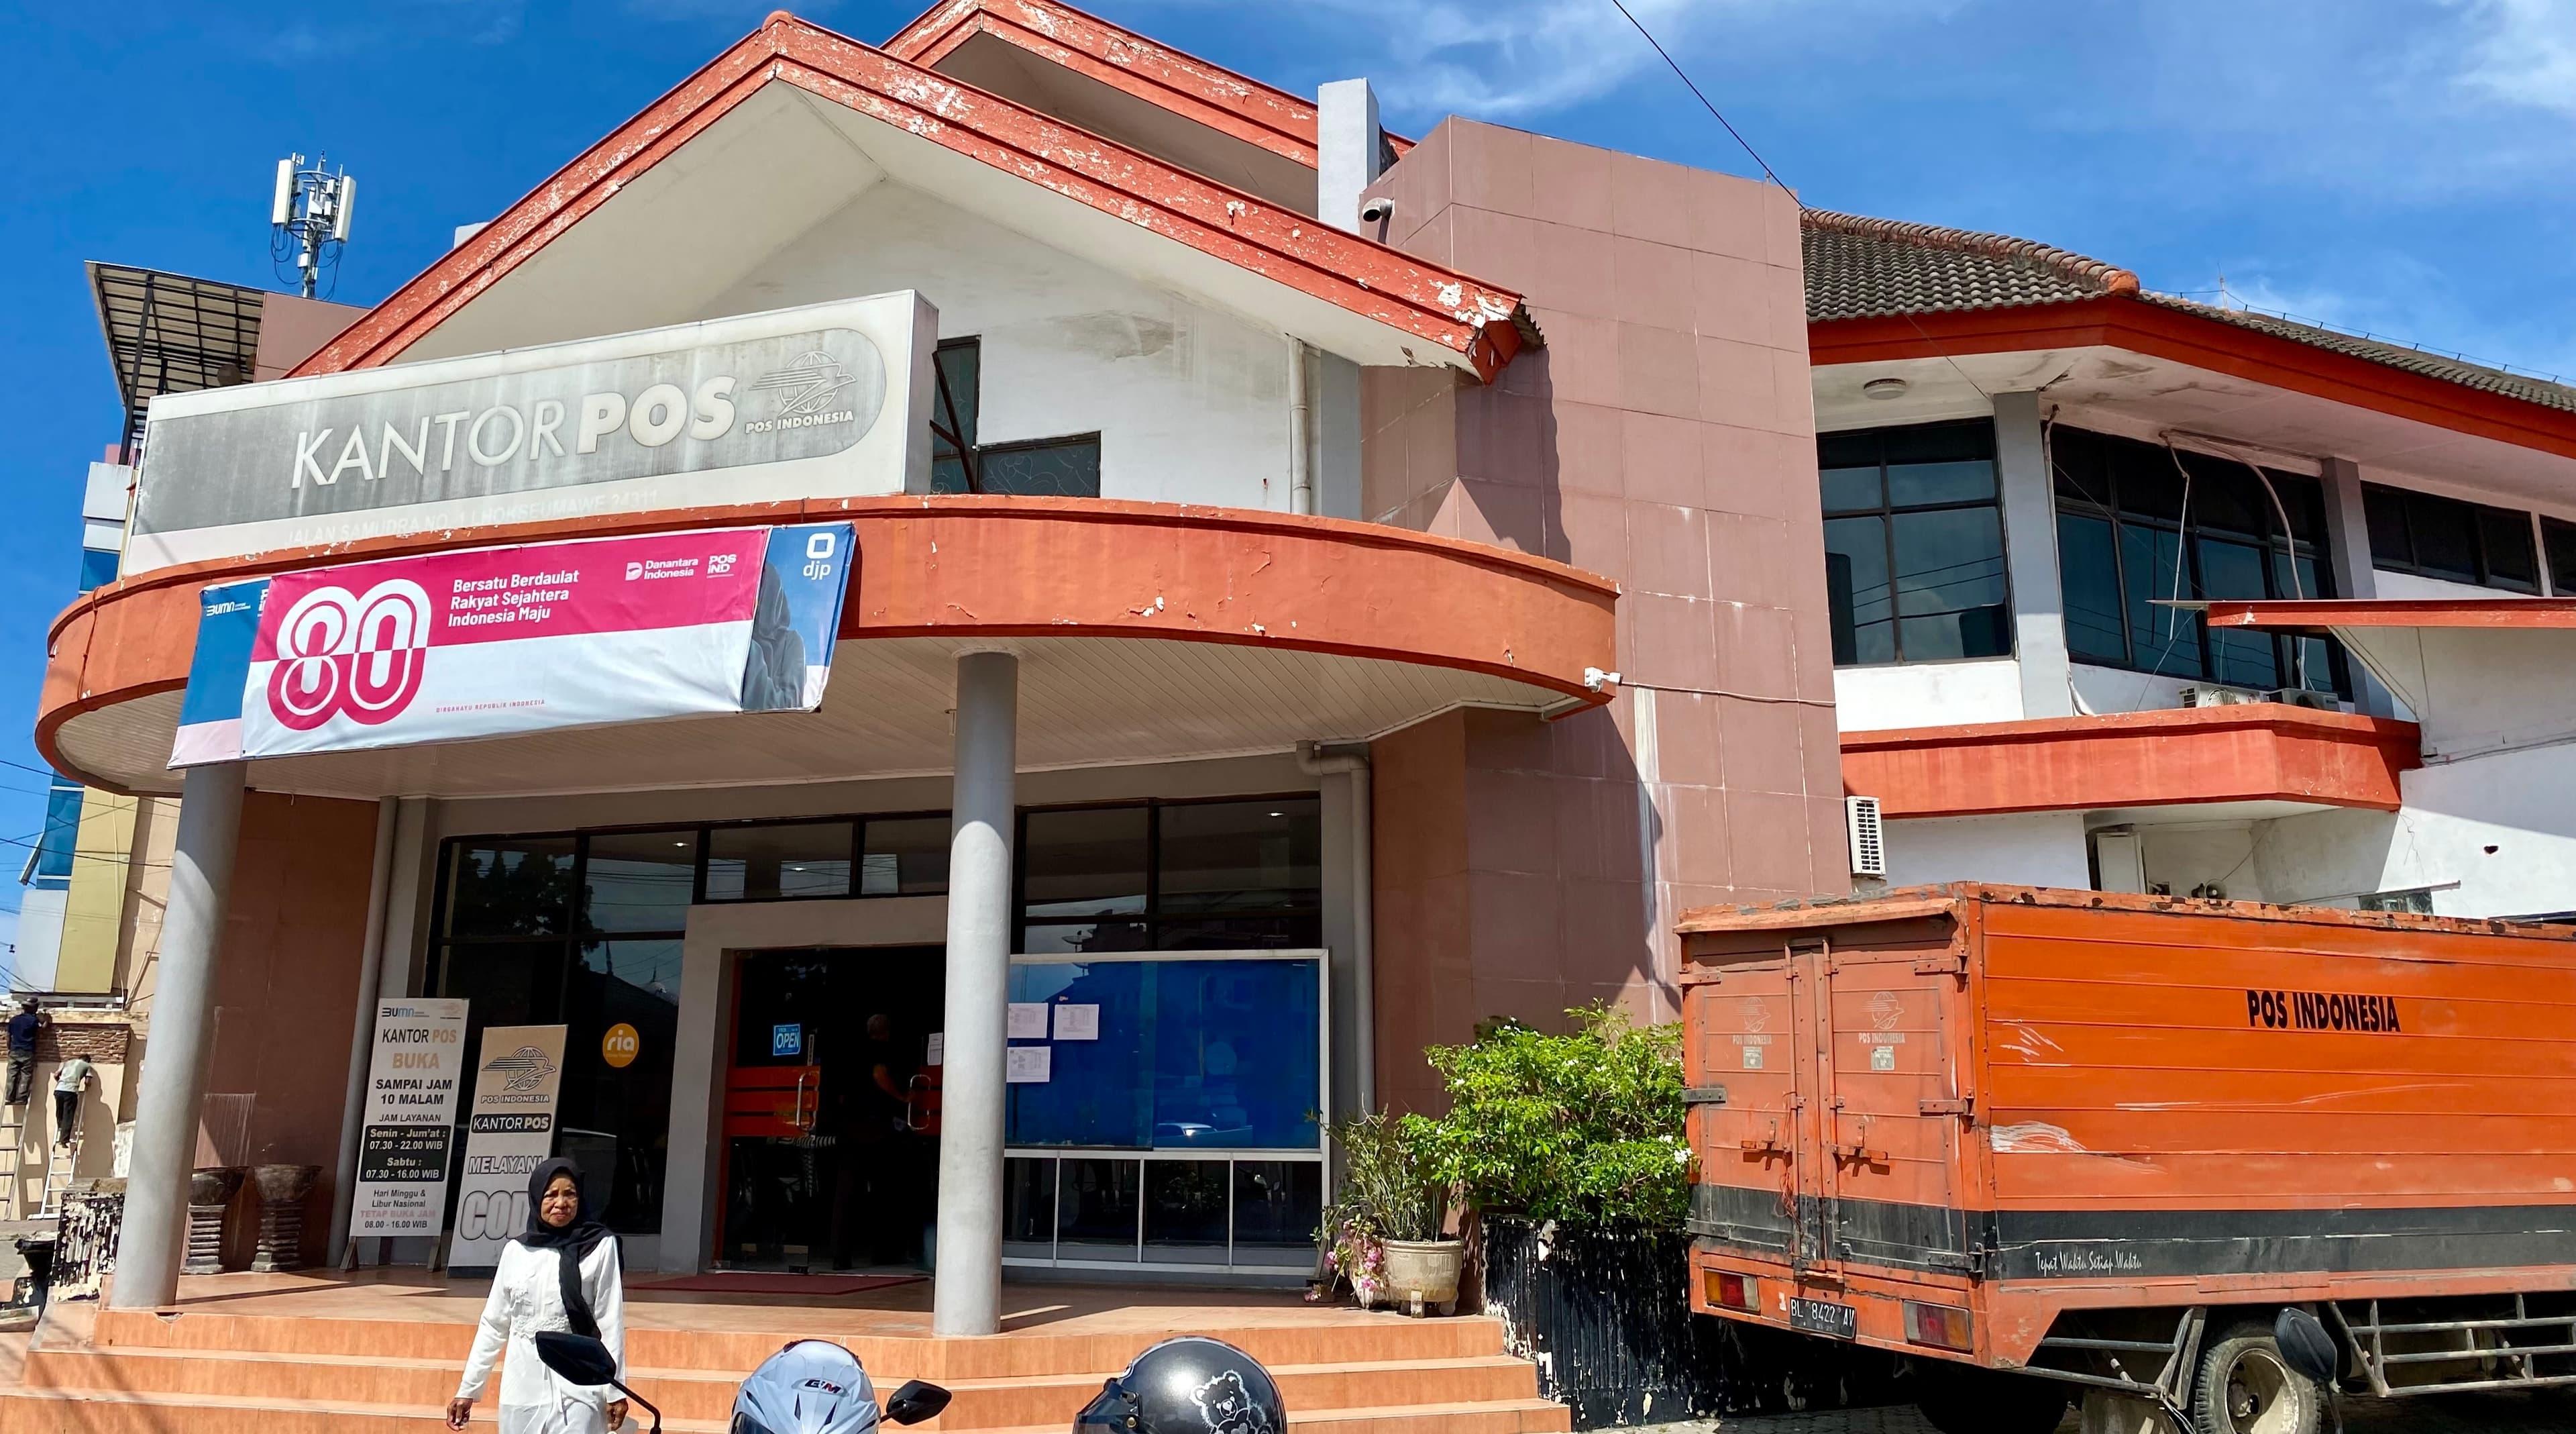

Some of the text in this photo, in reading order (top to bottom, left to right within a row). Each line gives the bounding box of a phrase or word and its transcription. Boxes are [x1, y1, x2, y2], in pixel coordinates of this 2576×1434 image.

[745, 409, 855, 435] POS INDONESIA
[291, 374, 737, 489] KANTOR POS
[286, 525, 337, 546] JALAN
[339, 517, 419, 541] SAMUDRA
[472, 494, 608, 523] LHOKSEUMAWE
[645, 553, 737, 570] Danantara POS
[643, 567, 695, 580] Indonesia
[802, 560, 832, 580] djp
[453, 570, 580, 593] Bersatu Berdaulat
[450, 588, 570, 611] Rakyat Sejahtera
[447, 605, 551, 627] Indonesia Maju
[266, 578, 431, 731] 80
[435, 699, 545, 713] DIRGAHAYU REPUBLIK INDONESIA
[2246, 989, 2402, 1033] POS INDONESIA
[382, 1028, 457, 1043] KANTOR POS
[606, 1029, 635, 1052] ria
[776, 1032, 800, 1049] OPEN
[1858, 1032, 1871, 1044] POS
[392, 1052, 440, 1069] BUKA
[376, 1079, 453, 1090] SAMPAI JAM
[380, 1093, 444, 1105] 10 MALAM
[480, 1094, 550, 1104] POS INDONESIA
[378, 1114, 441, 1123] JAM LAYANAN
[473, 1116, 549, 1130] KANTOR POS
[370, 1128, 398, 1138] Senin
[406, 1128, 440, 1138] Jum'at
[369, 1141, 393, 1150] 07.30
[400, 1141, 423, 1150] 22.00
[425, 1141, 443, 1150] WIB
[386, 1157, 417, 1167] Sabtu
[366, 1169, 389, 1179] 07.30
[396, 1169, 420, 1179] 16.00
[421, 1169, 440, 1179] WIB
[373, 1189, 426, 1199] Hari Minggu &
[372, 1199, 426, 1208] Libur Nasional
[360, 1210, 436, 1218] TETAP BUKA JAM
[364, 1220, 384, 1229] 08.00
[391, 1220, 411, 1229] 16.00
[412, 1220, 428, 1229] WIB
[2035, 1251, 2058, 1277] Tepat
[2088, 1250, 2113, 1276] Setiap
[1790, 1298, 1855, 1327] BL 8422 AV
